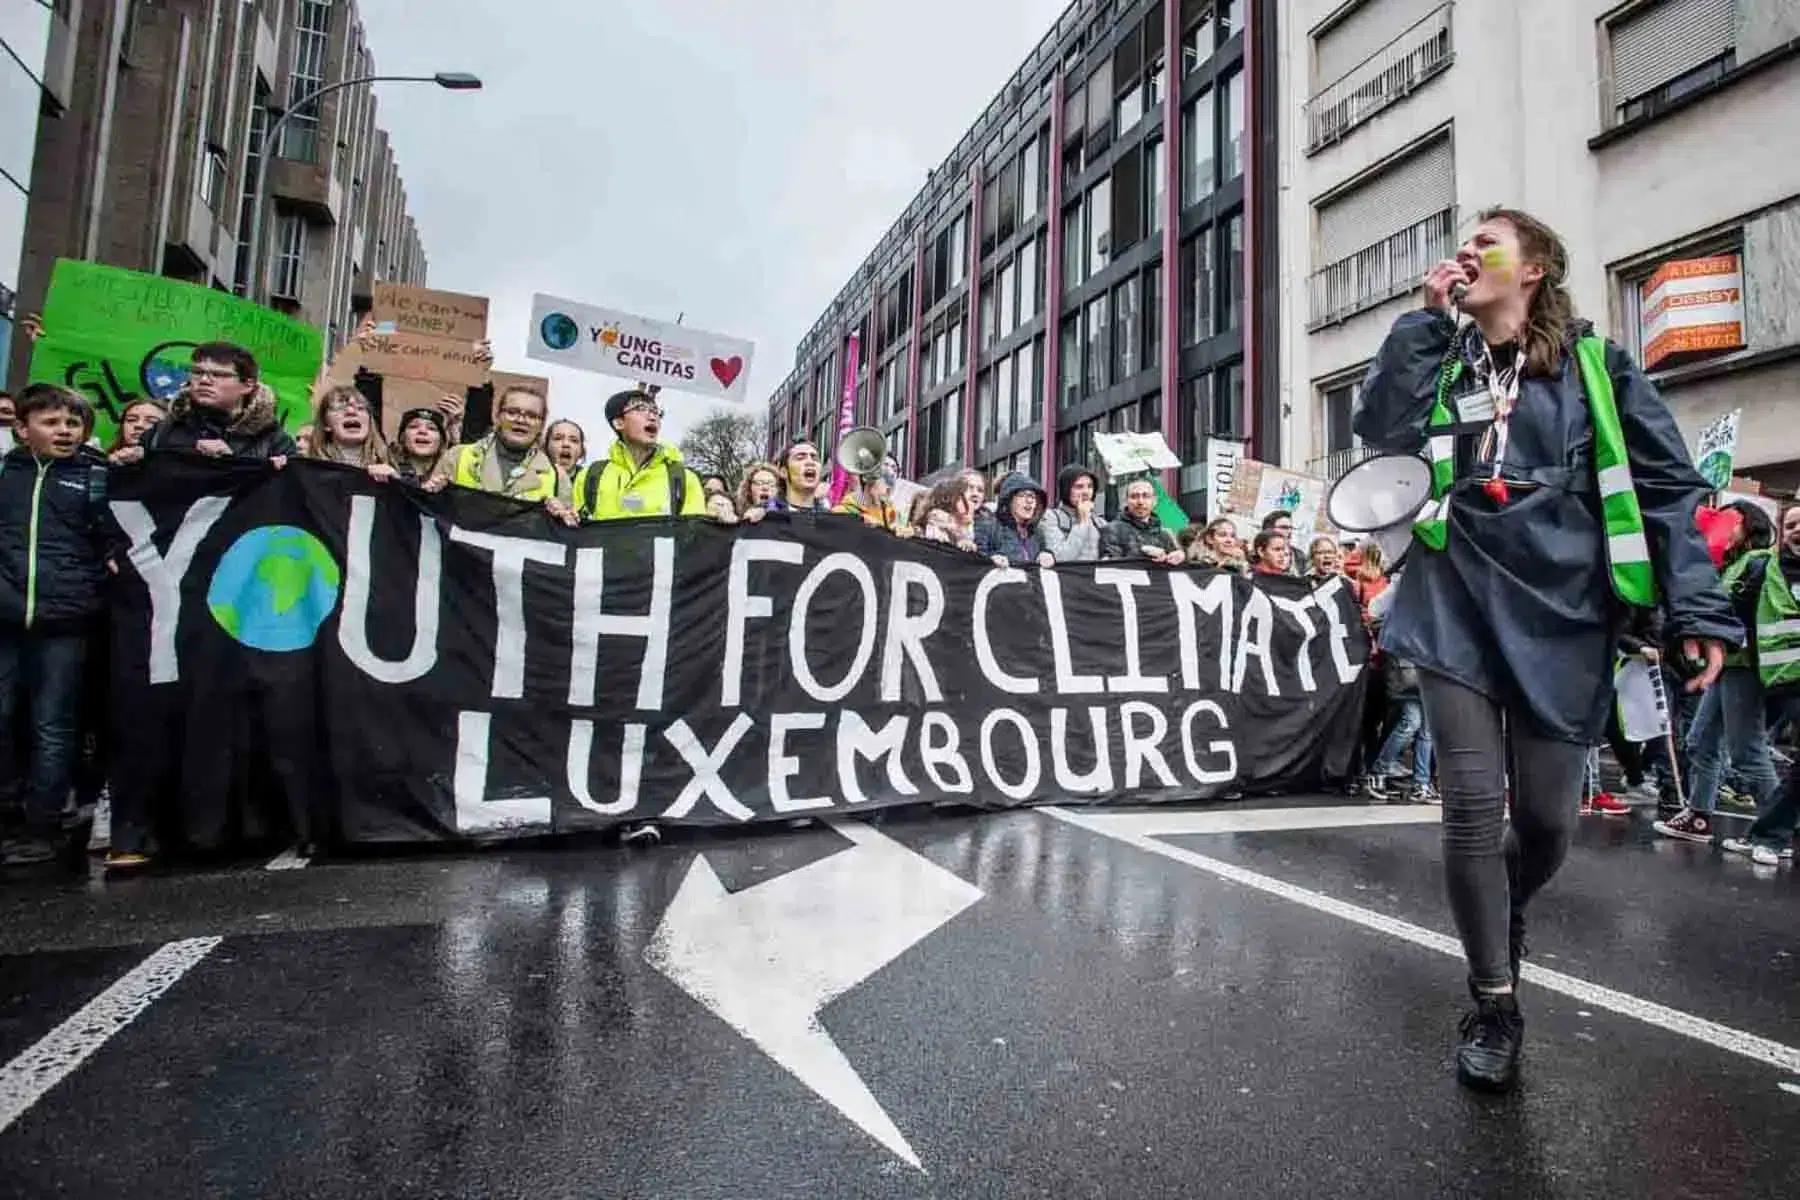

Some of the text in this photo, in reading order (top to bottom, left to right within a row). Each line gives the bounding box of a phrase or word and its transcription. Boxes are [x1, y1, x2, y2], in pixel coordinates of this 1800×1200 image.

[590, 327, 663, 356] YOUNG
[616, 351, 695, 380] CARITAS
[110, 494, 1366, 711] YOUTH FOR CLIMATE
[453, 699, 1238, 831] LUXEMBOURG
